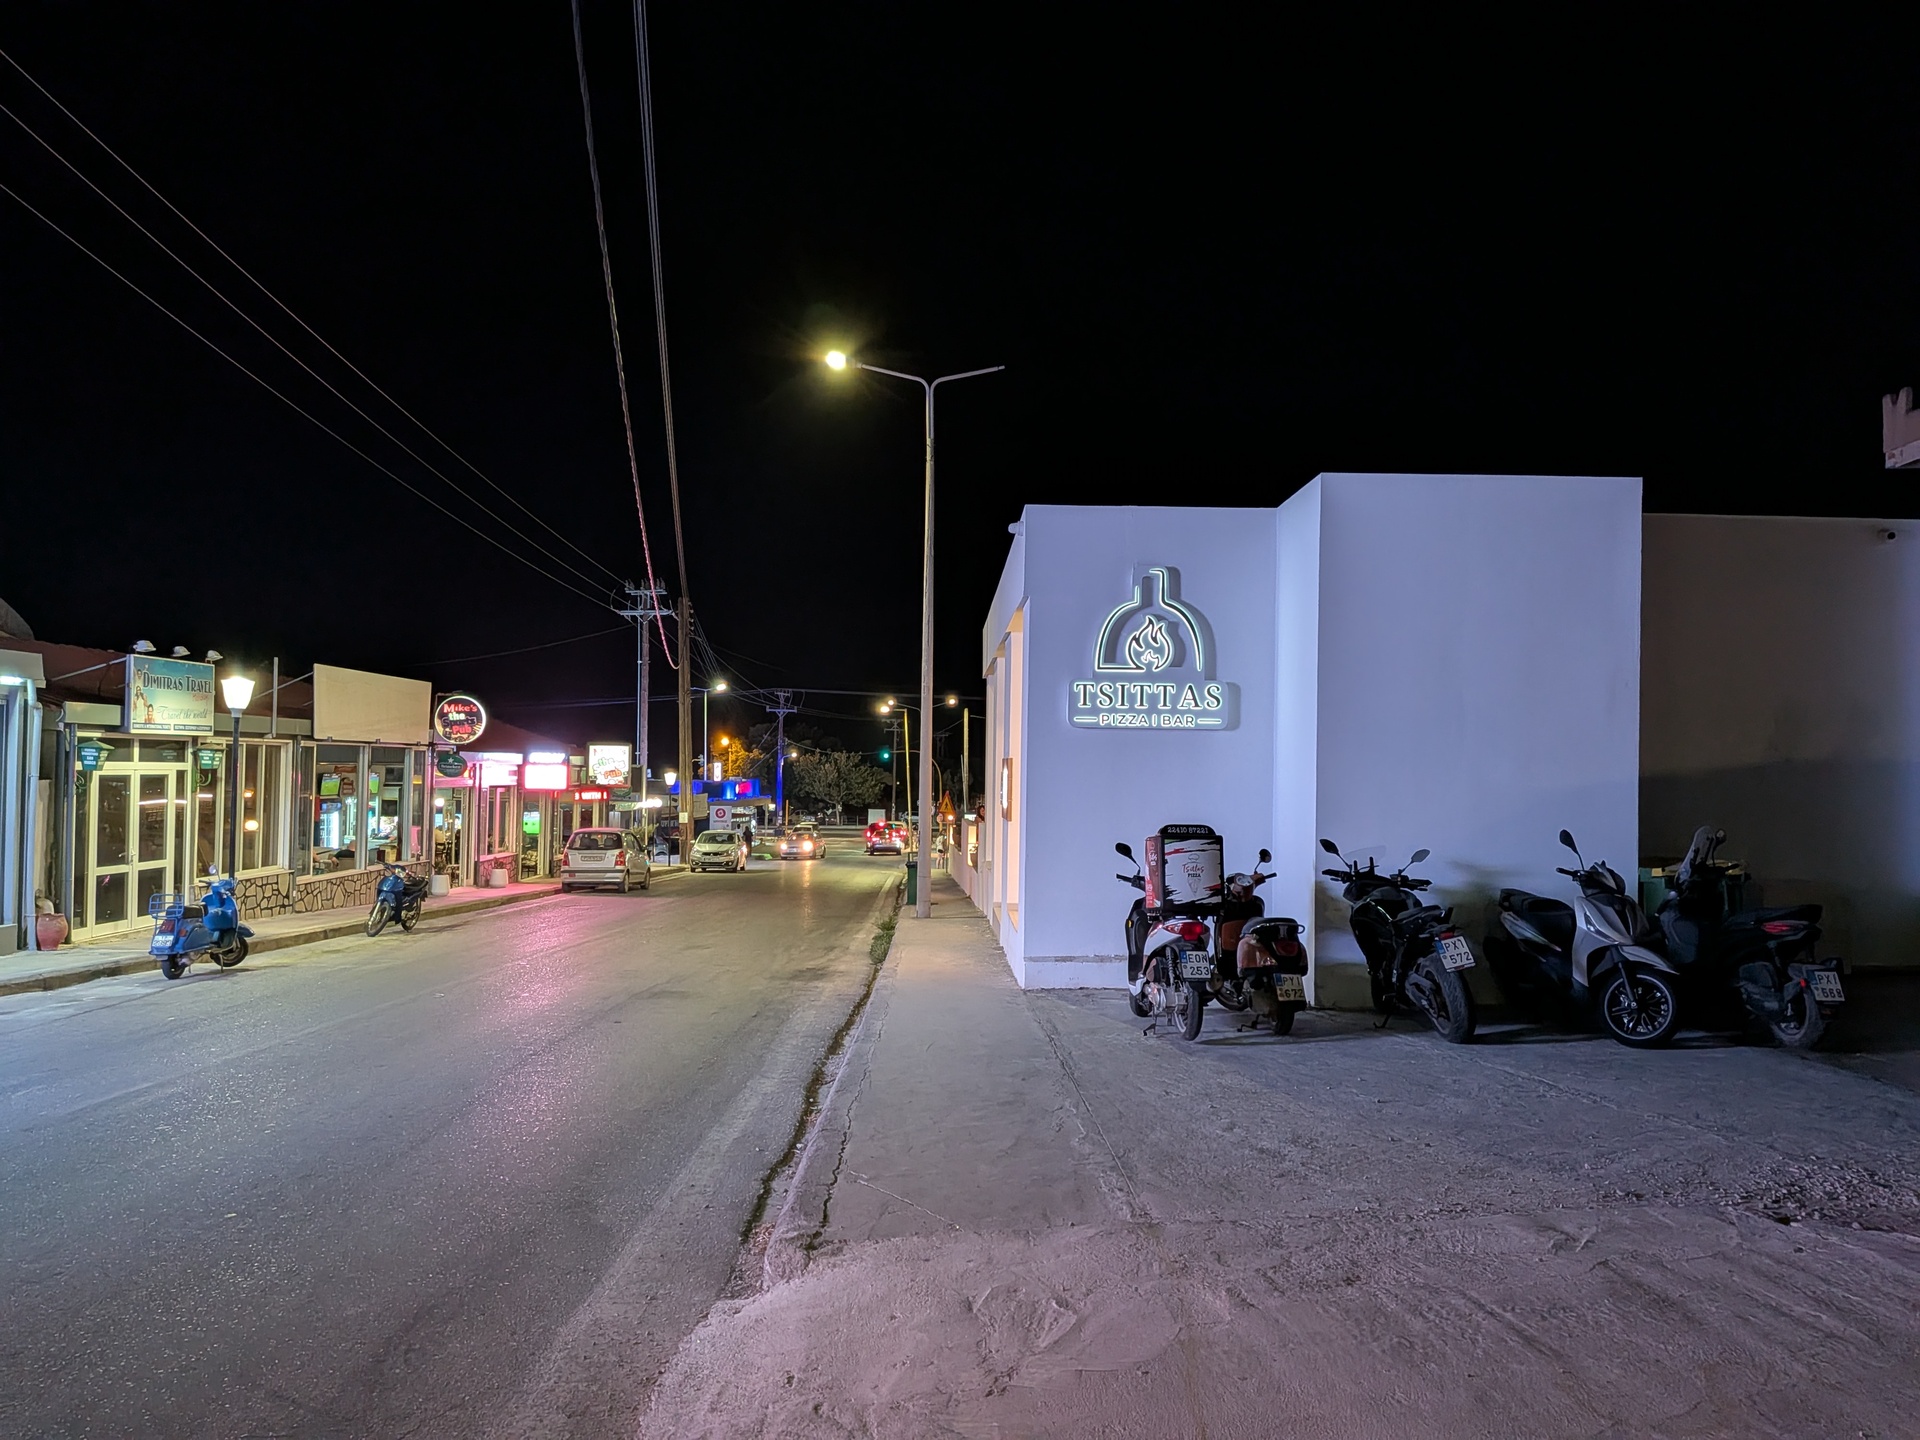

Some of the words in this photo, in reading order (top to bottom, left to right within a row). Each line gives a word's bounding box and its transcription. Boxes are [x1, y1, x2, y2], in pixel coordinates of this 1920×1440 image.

[1073, 681, 1223, 710] TSITTAS
[443, 703, 478, 713] Mike's
[448, 711, 466, 721] the
[1099, 714, 1149, 727] PIZZA
[1161, 714, 1196, 728] BAR
[451, 724, 473, 735] Pub
[603, 767, 623, 780] Pub
[1188, 953, 1209, 963] EON
[1449, 951, 1473, 965] 572
[1189, 966, 1210, 976] 253
[1284, 988, 1304, 998] 672
